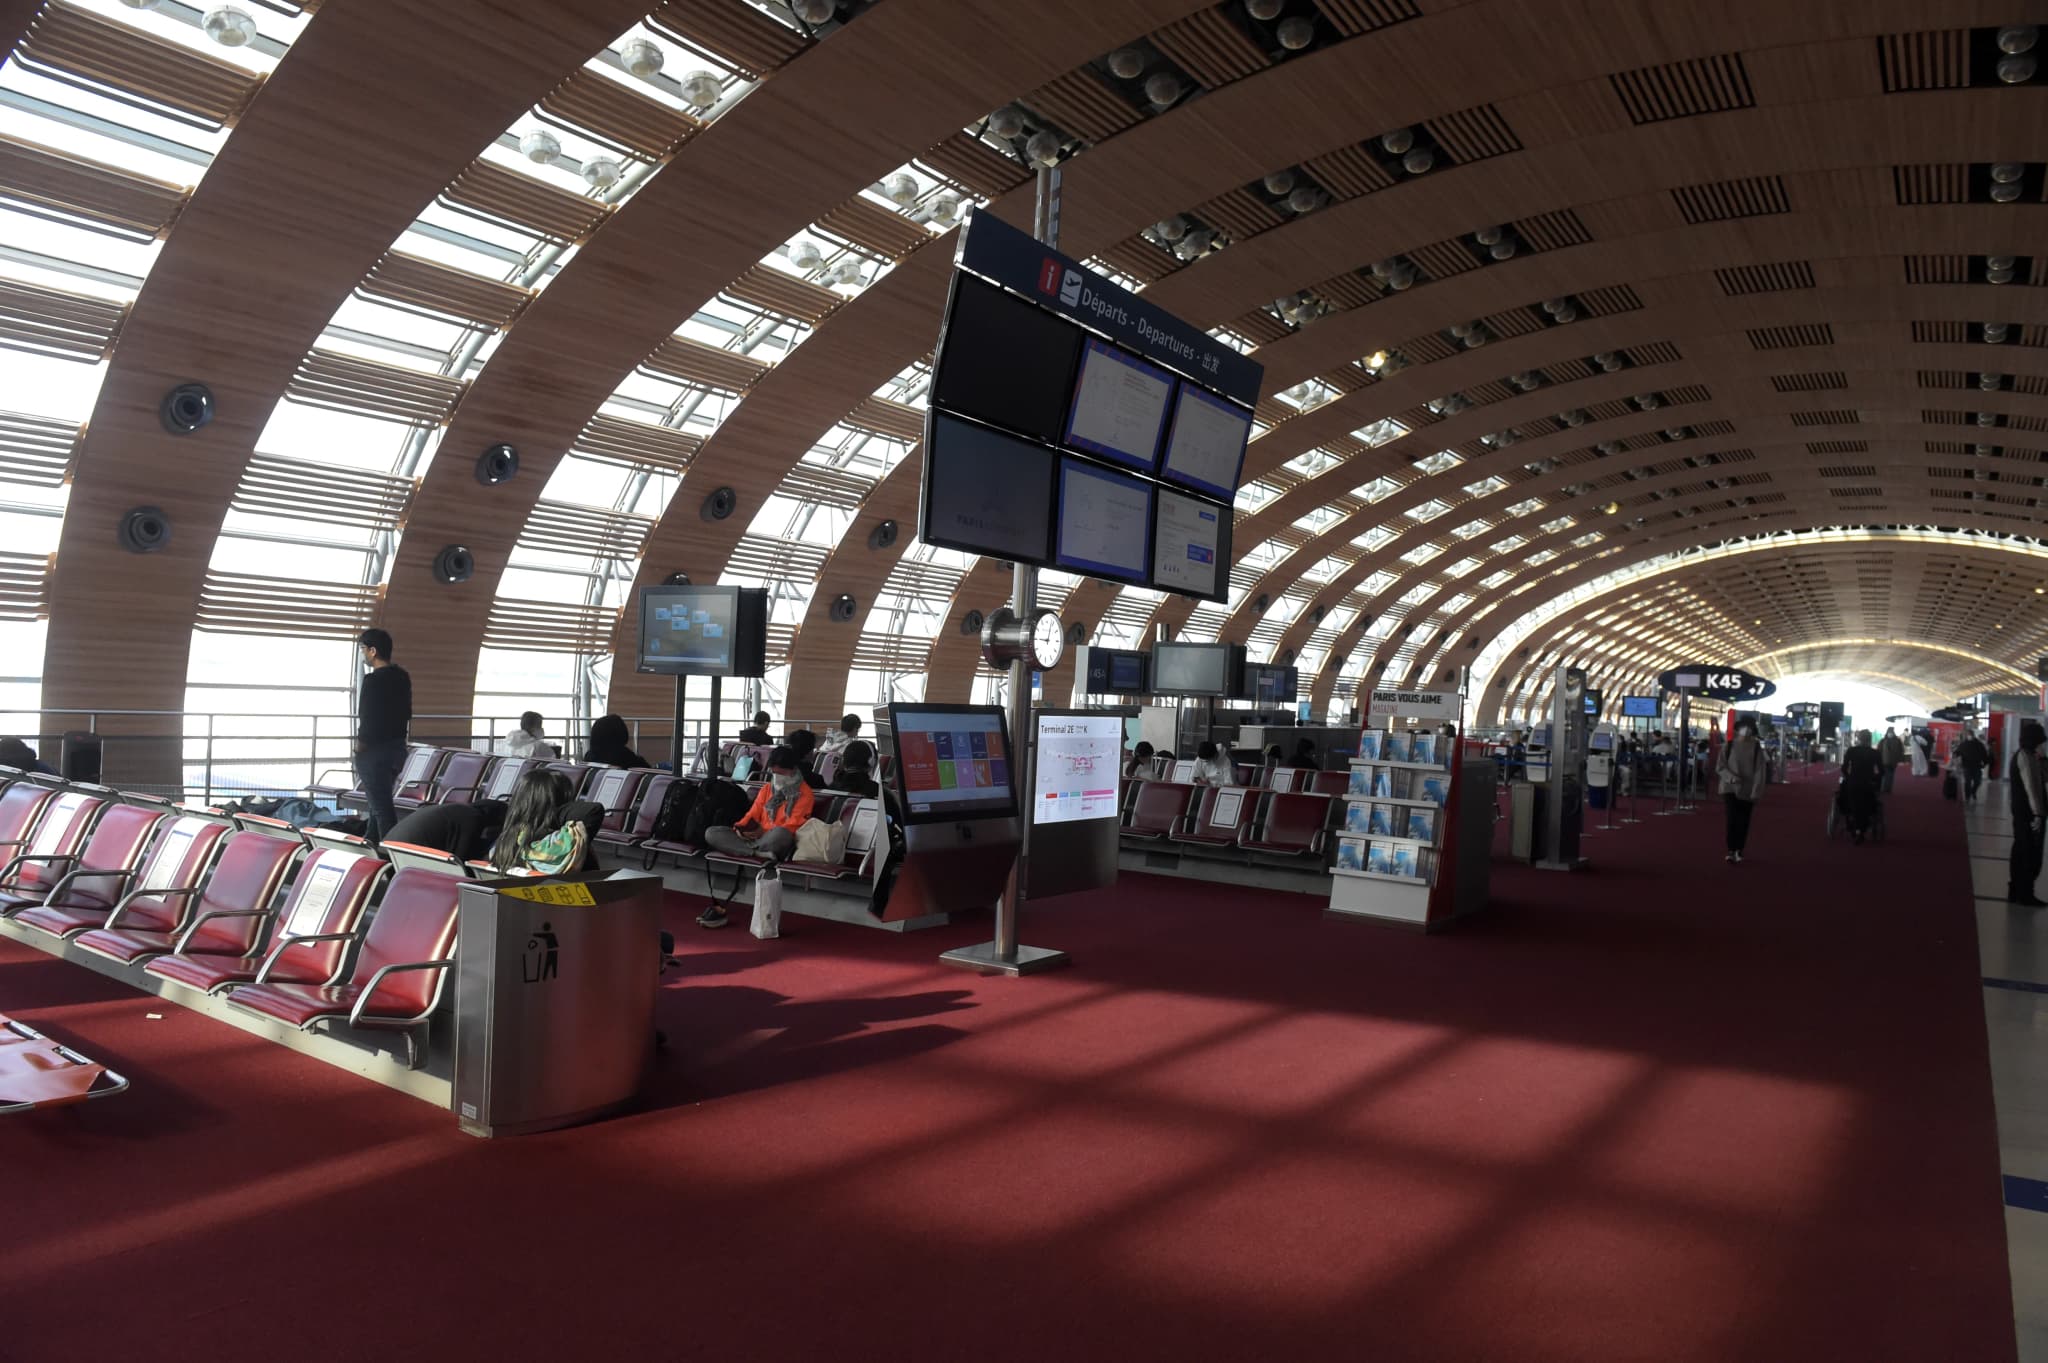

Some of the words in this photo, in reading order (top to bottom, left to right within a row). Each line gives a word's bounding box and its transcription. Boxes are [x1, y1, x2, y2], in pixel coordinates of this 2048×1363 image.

[1081, 288, 1128, 326] Départs
[1137, 317, 1195, 361] Departures
[1202, 352, 1221, 375] 出发
[1706, 673, 1742, 689] K45
[1373, 692, 1397, 702] PARIS
[1397, 693, 1420, 703] VOUS
[1420, 694, 1442, 704] AIME
[1372, 703, 1398, 714] MAGAZINE
[1041, 724, 1067, 734] Terminal
[1067, 724, 1074, 734] 2E
[1083, 724, 1088, 734] K
